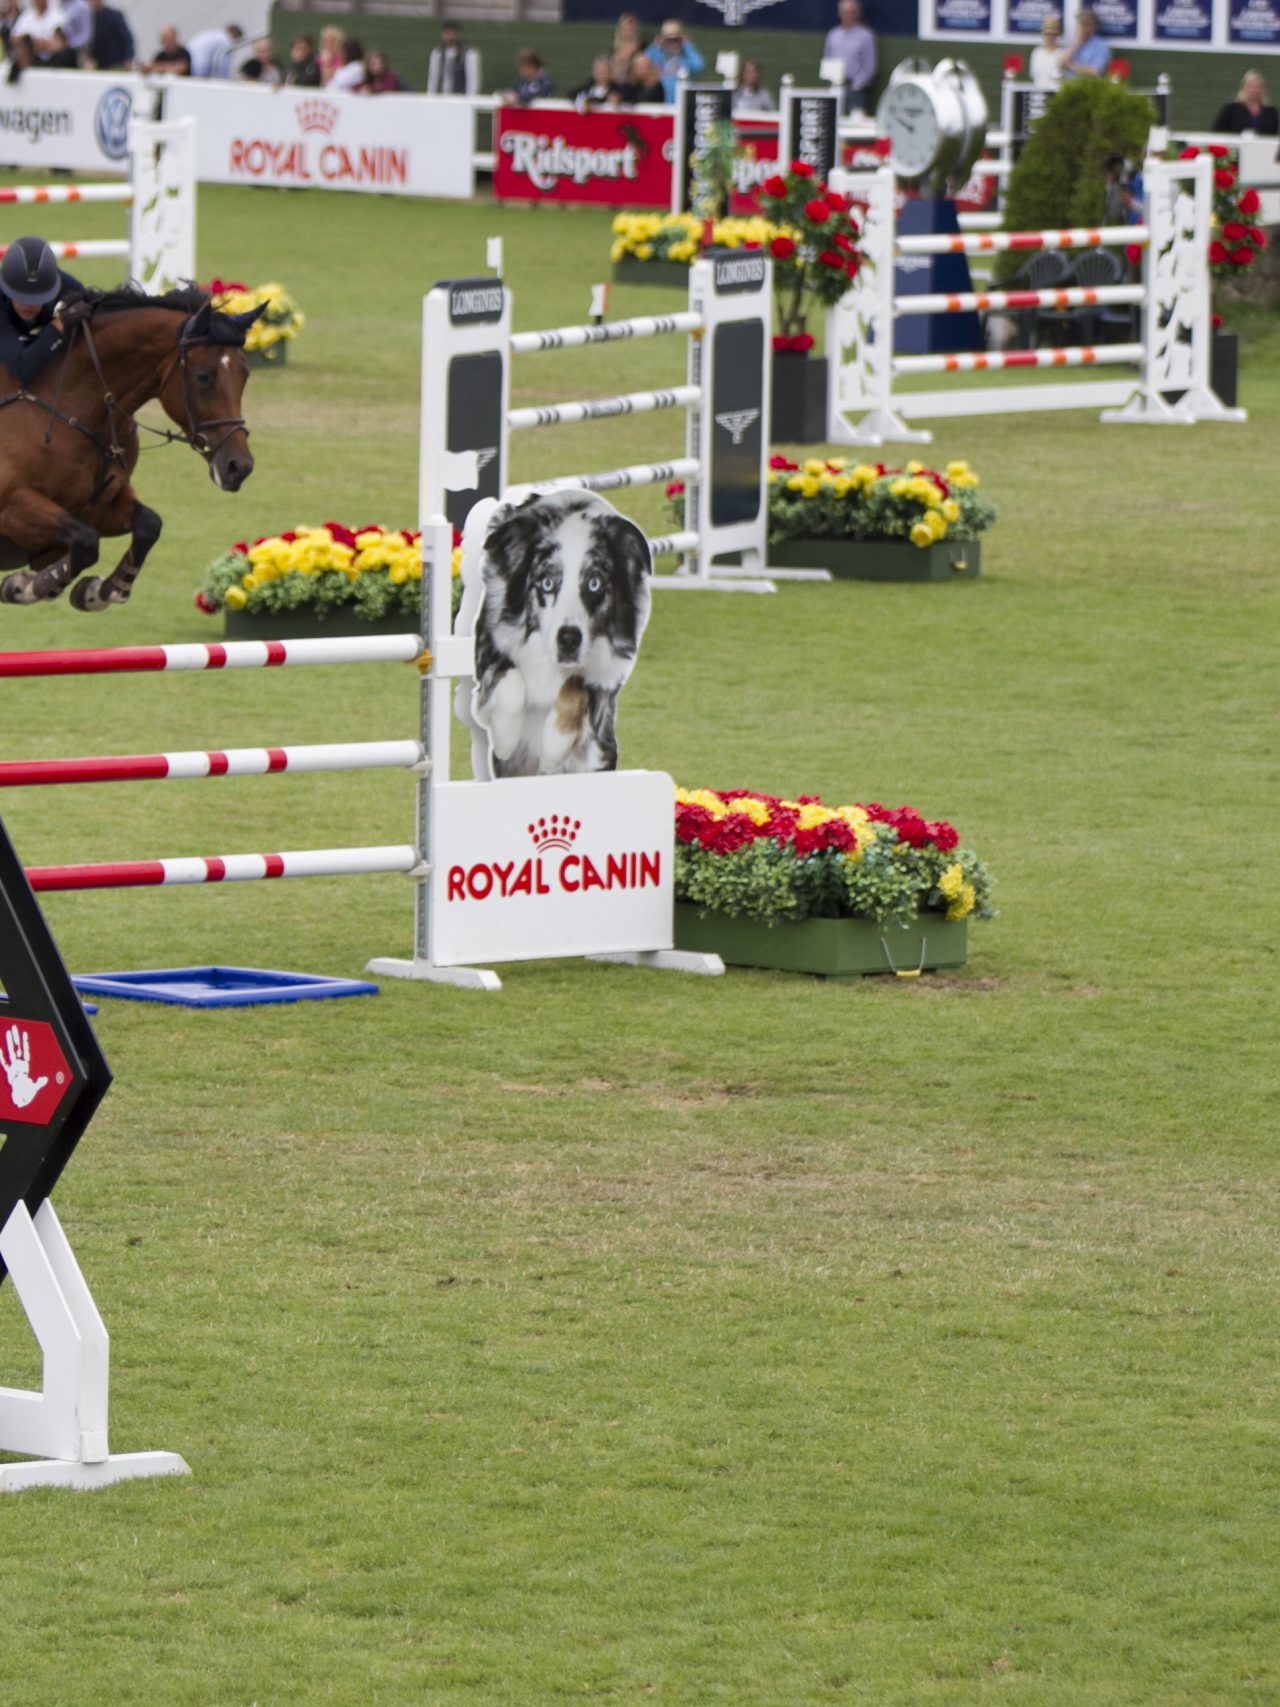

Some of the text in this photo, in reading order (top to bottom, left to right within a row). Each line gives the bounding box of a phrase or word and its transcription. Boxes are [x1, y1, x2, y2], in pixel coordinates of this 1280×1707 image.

[229, 138, 409, 185] ROYAL CANIN
[500, 130, 638, 190] Ridsport
[716, 257, 764, 286] LONGINES
[451, 287, 502, 315] LONGINES
[448, 851, 660, 902] ROYAL CANIN
